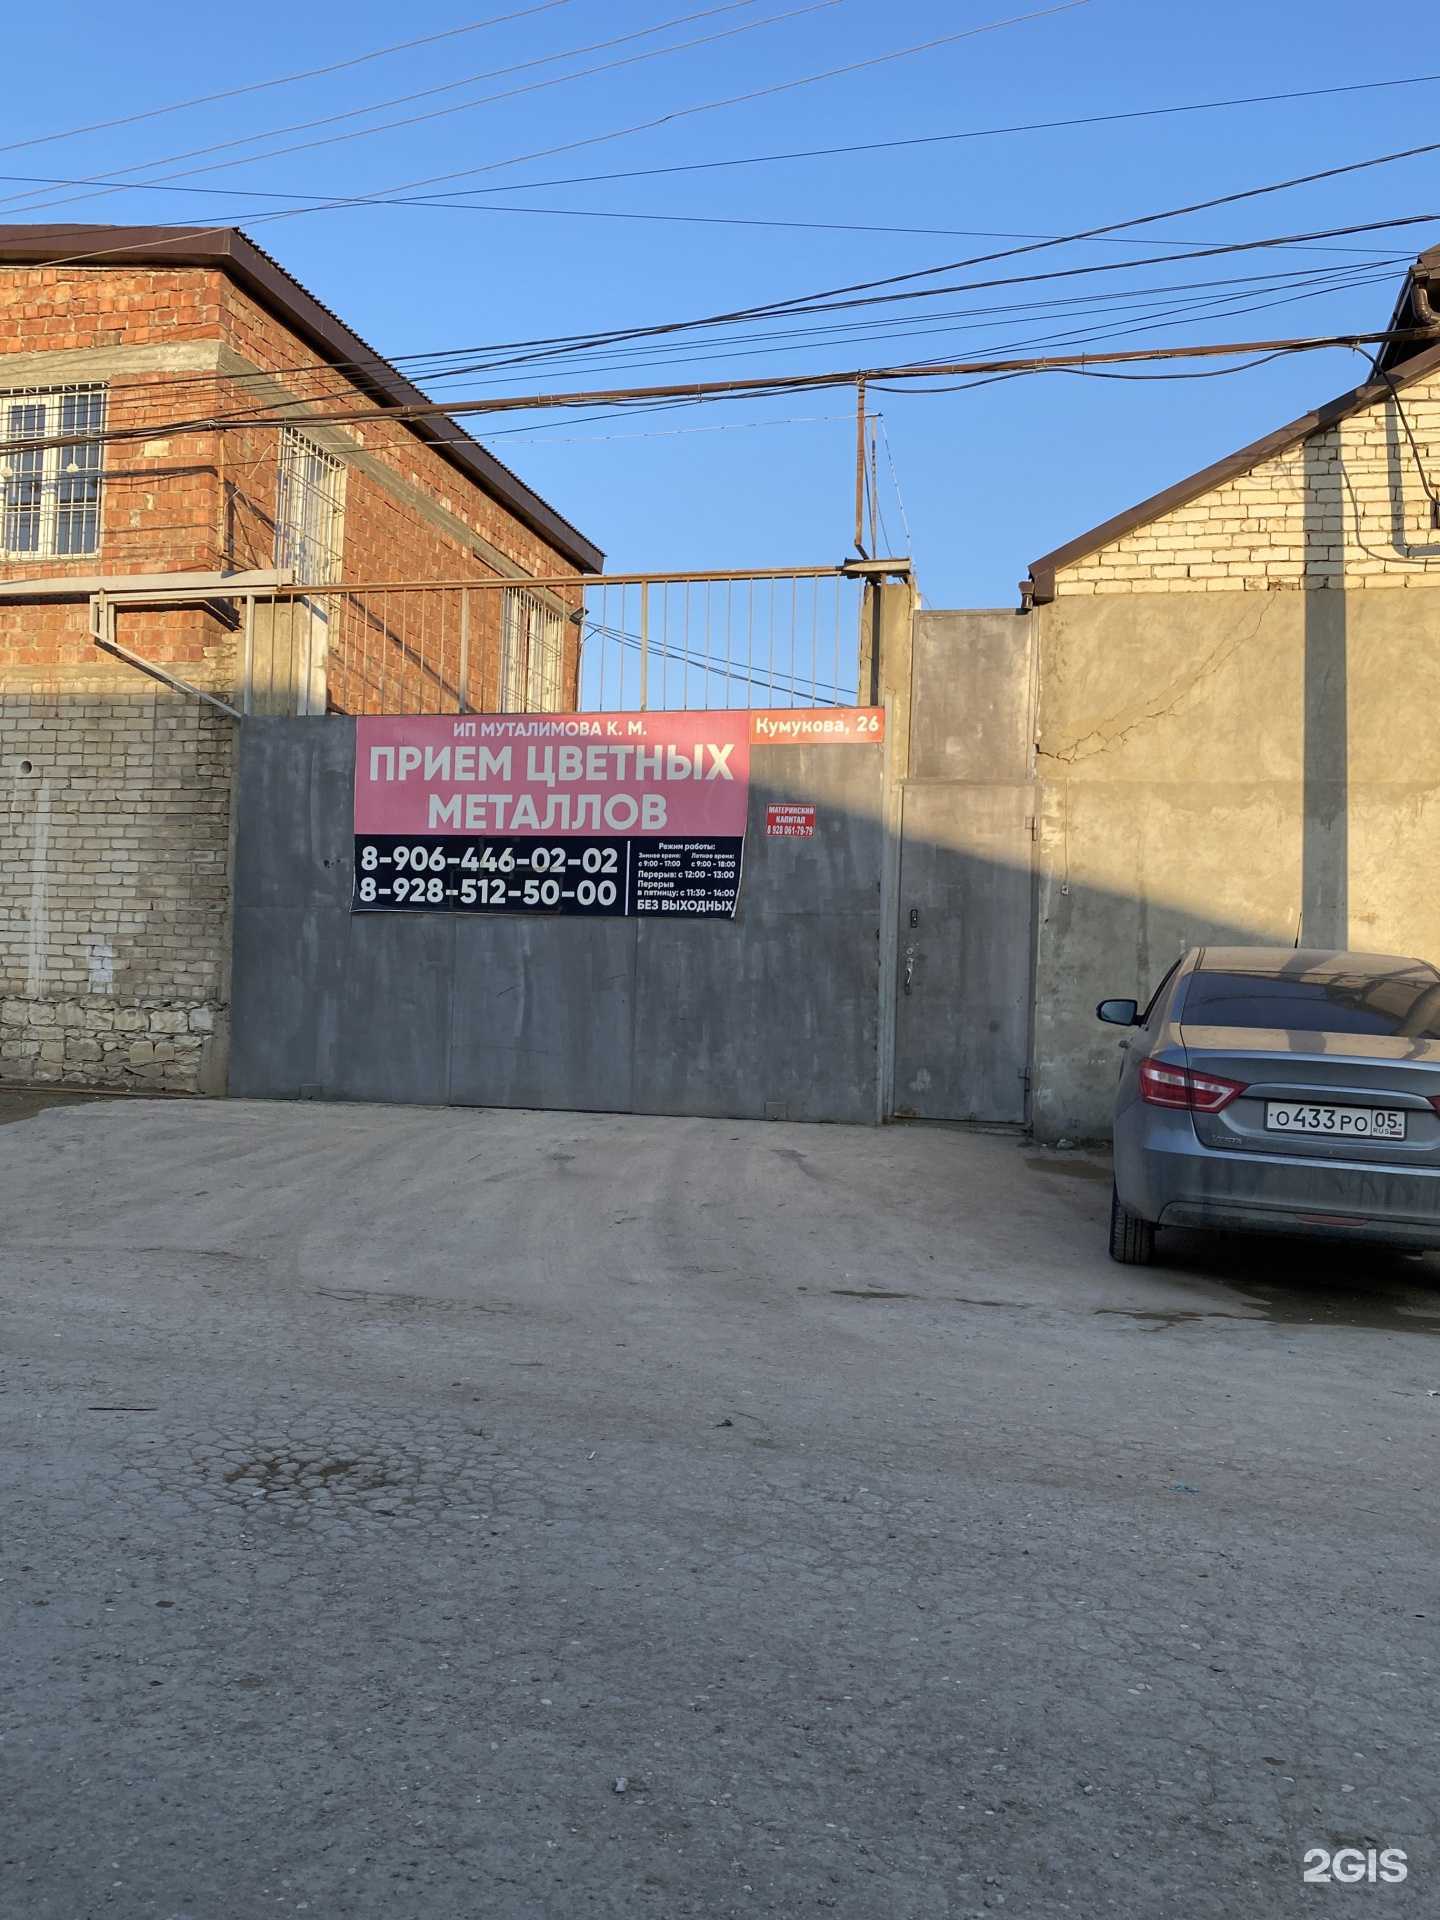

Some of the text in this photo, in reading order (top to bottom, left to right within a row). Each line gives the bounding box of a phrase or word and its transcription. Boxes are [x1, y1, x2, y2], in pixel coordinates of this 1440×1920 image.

[453, 720, 648, 737] ИП МУТАЛИМОВА К. М.
[756, 715, 879, 737] Кумукова, 26
[369, 743, 735, 787] ПРИЕМ ЦВЕТНЫХ
[428, 793, 668, 831] МЕТАЛЛОВ
[775, 815, 806, 824] КАПИТАЛ
[658, 842, 716, 852] Режим работы:
[361, 845, 618, 874] 8-906-446-02-02
[696, 860, 712, 868] 9:00
[718, 860, 736, 868] 18:00
[638, 870, 677, 880] Перерыв:
[684, 870, 706, 878] 12:00
[713, 870, 735, 879] 13:00
[359, 877, 617, 907] 8-928-512-50-00
[637, 880, 675, 889] Перерыв
[644, 889, 679, 898] пятницу:
[686, 888, 706, 897] 11:30
[713, 888, 735, 897] 14:00
[637, 899, 734, 913] БЕЗ ВЫХОДНЫХ
[1375, 1112, 1398, 1129] 05
